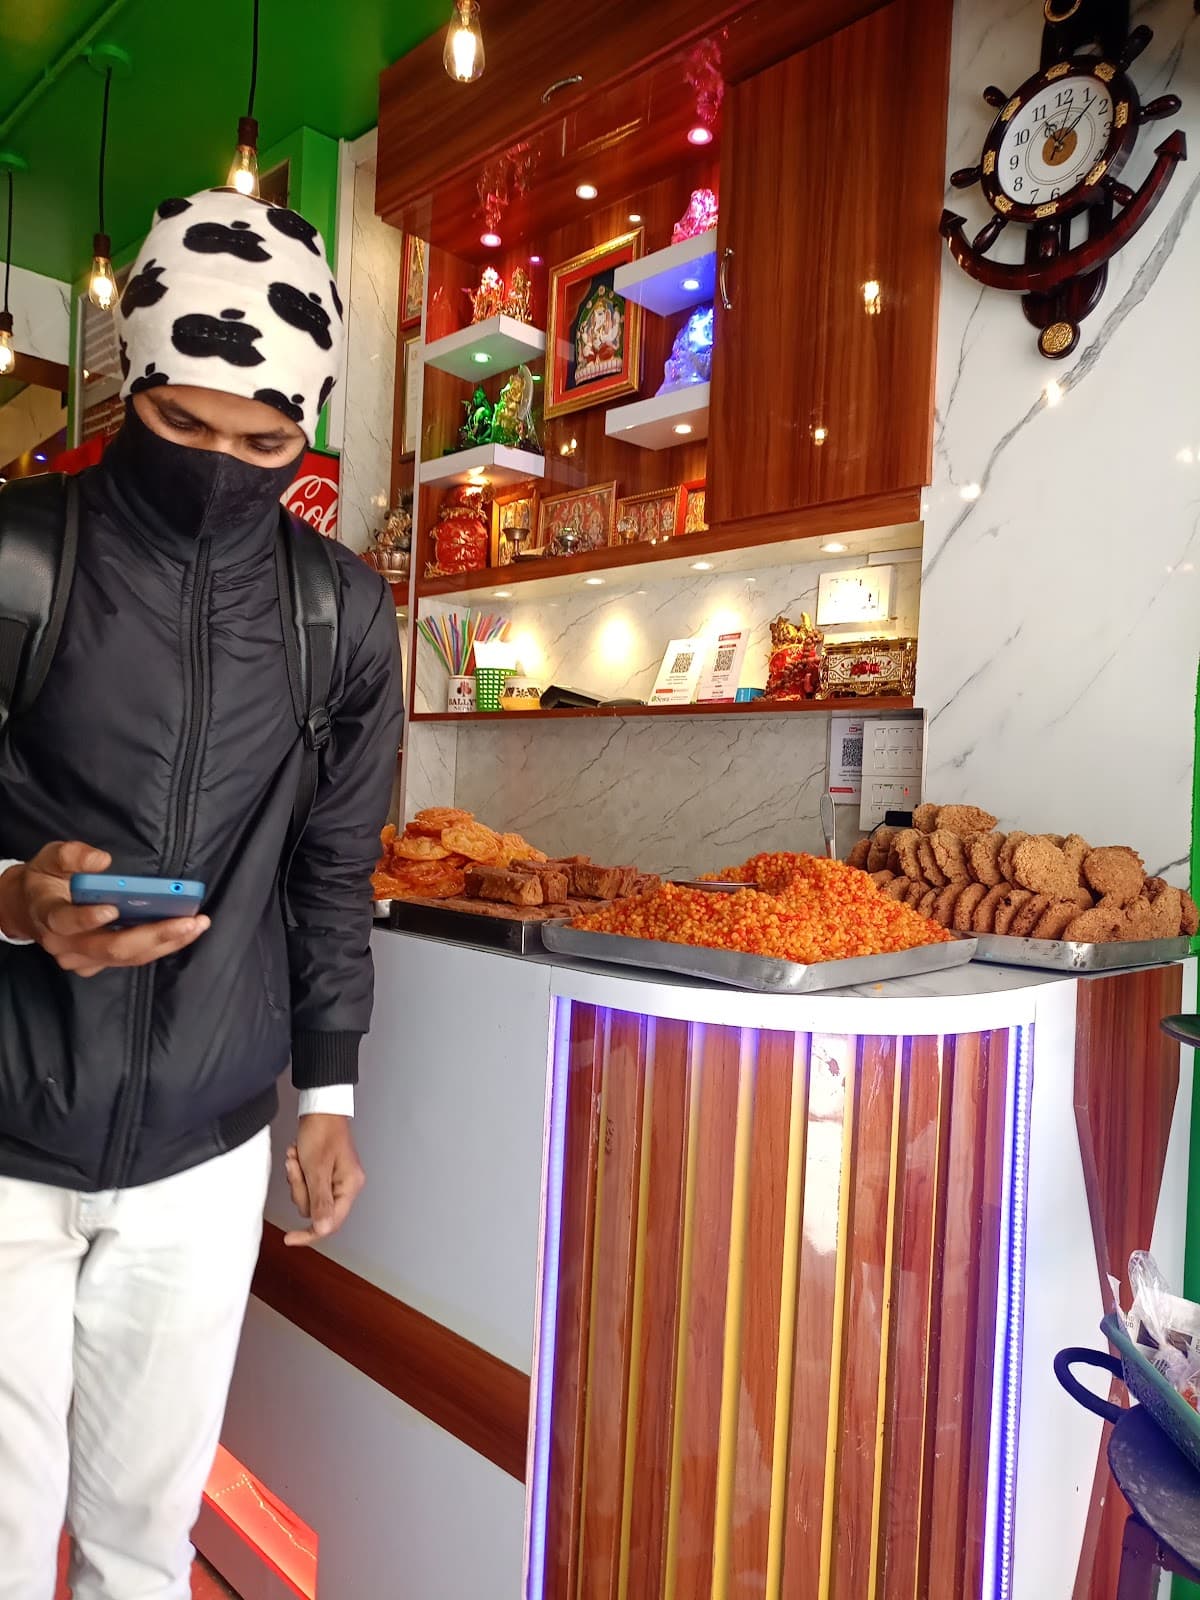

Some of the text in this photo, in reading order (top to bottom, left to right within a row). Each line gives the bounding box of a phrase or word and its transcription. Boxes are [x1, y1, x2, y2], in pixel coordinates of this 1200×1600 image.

[1054, 88, 1073, 107] 12
[1083, 87, 1090, 102] 1
[1032, 104, 1047, 122] 11
[1098, 98, 1108, 116] 2
[1013, 128, 1030, 146] 10
[1010, 154, 1019, 170] 9
[1013, 176, 1023, 192] 8
[1030, 188, 1040, 205] 7
